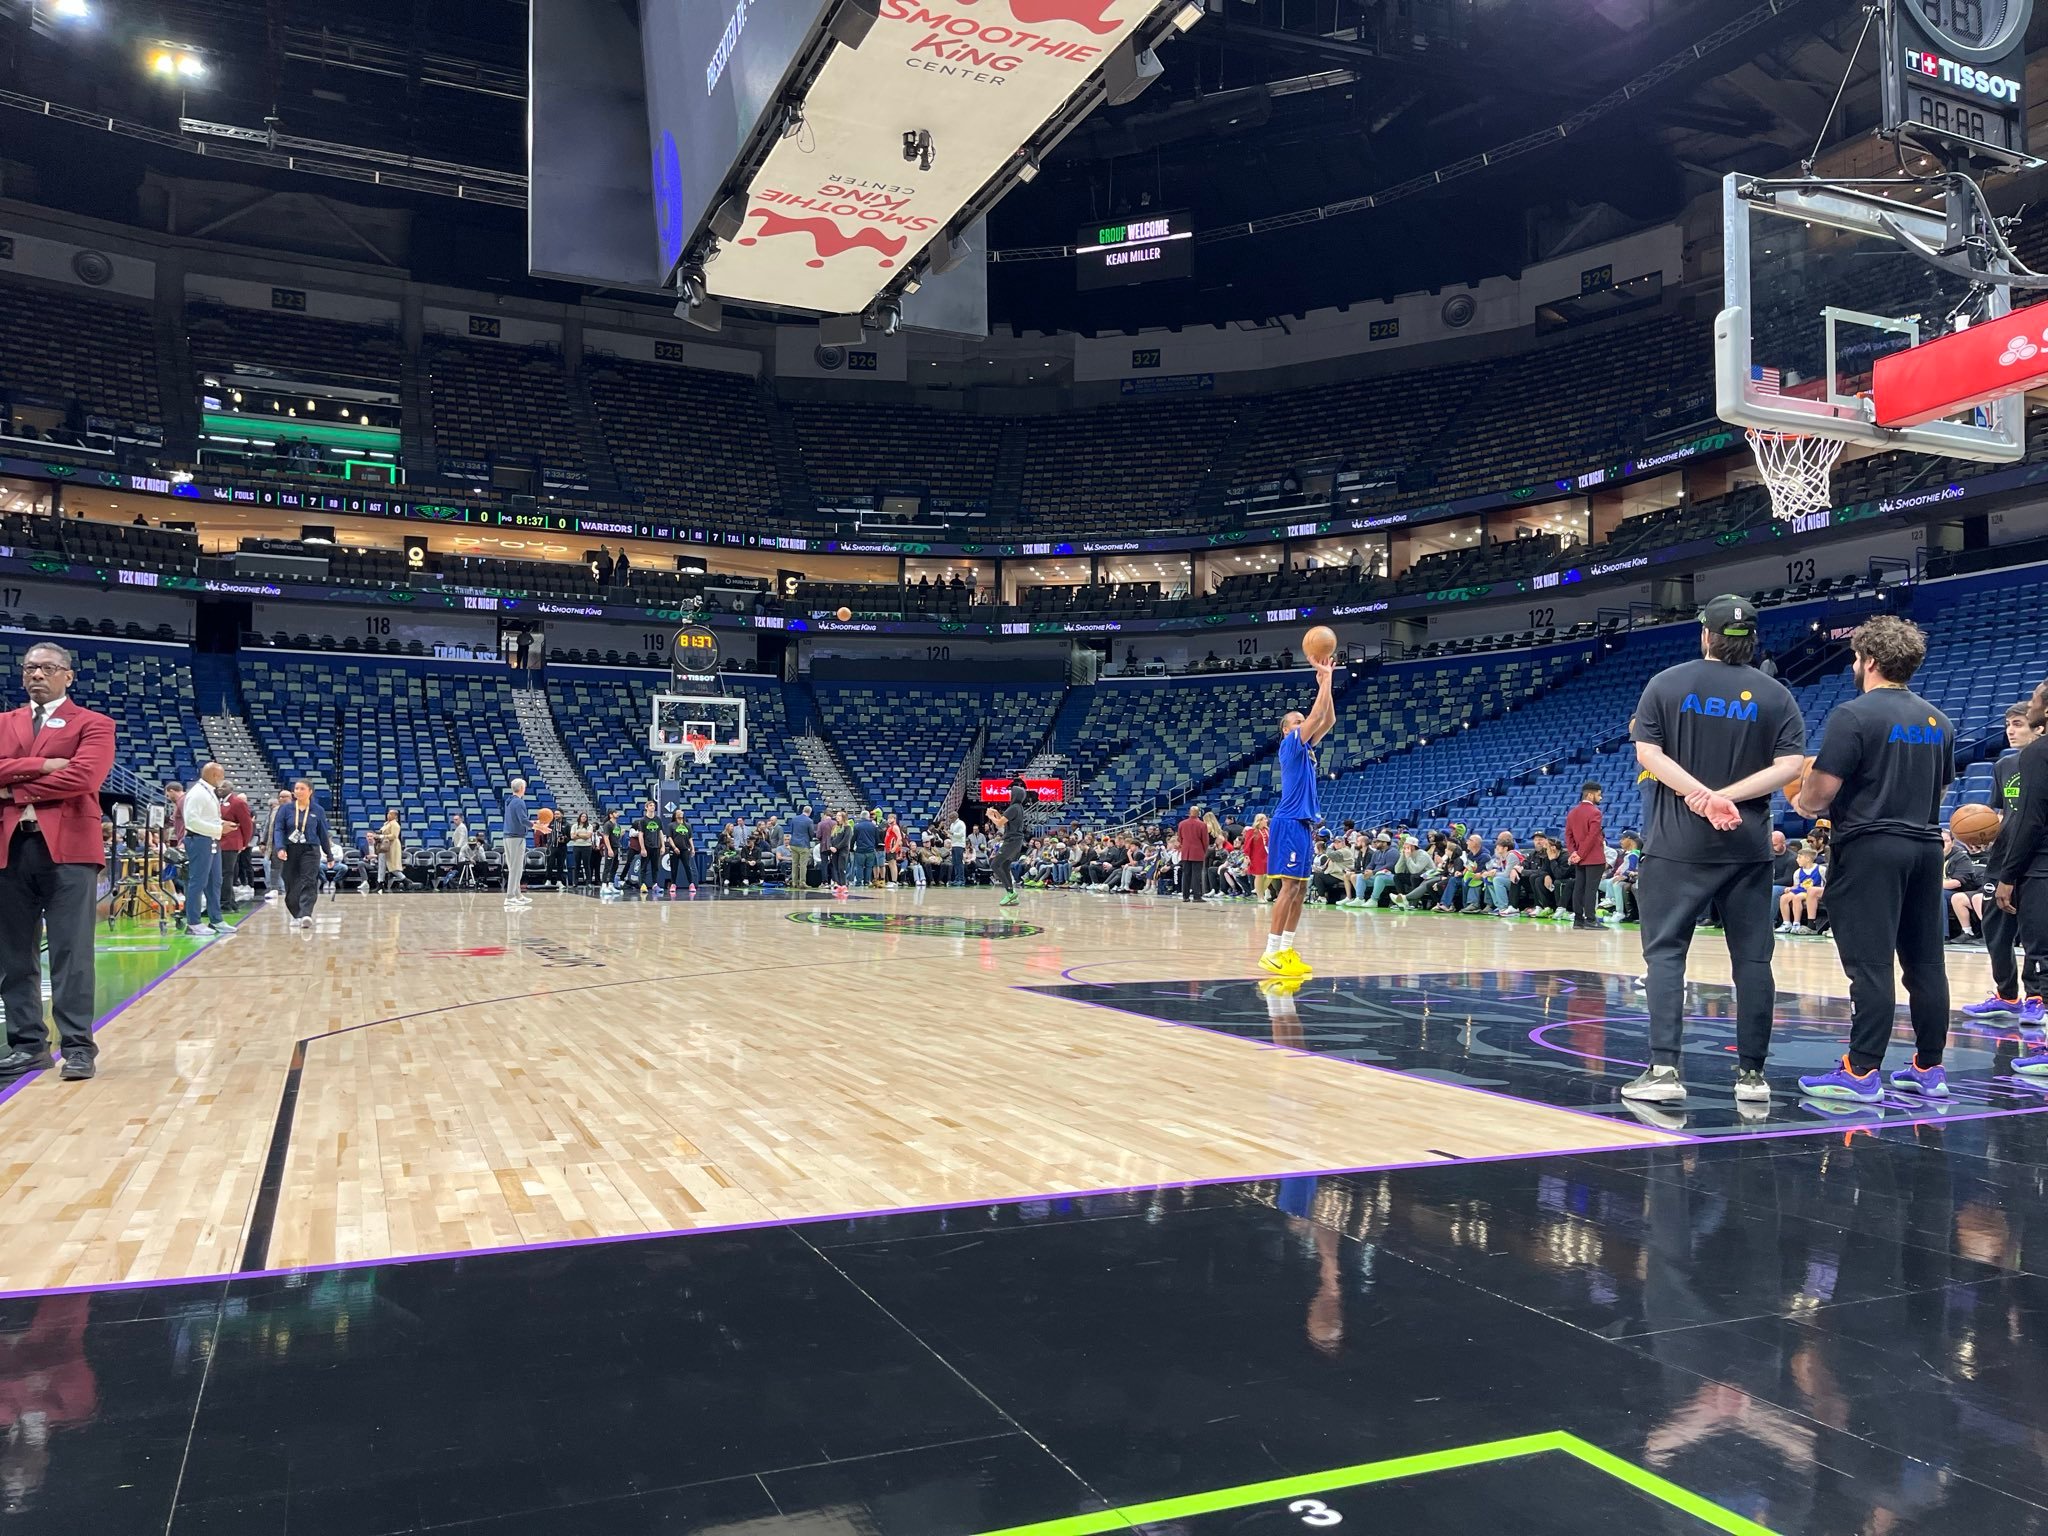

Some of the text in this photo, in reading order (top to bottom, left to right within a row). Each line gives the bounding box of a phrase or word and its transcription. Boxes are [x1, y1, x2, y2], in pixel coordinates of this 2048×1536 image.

[880, 0, 1102, 62] SMOOTHIE
[706, 15, 736, 96] PRESENTED
[906, 58, 1006, 86] CENTER
[1938, 57, 2020, 103] TISSOT
[829, 174, 915, 195] CENTER
[756, 188, 938, 231] SMOOTHIE
[1127, 219, 1170, 240] WELCOME
[1106, 247, 1160, 266] KEAN MILLER
[1583, 269, 1611, 288] 329
[470, 319, 498, 334] 324
[1370, 322, 1398, 338] 328
[656, 345, 682, 359] 325
[850, 355, 876, 367] 326
[1134, 352, 1159, 366] 327
[147, 478, 170, 493] NIGHT
[1589, 470, 1604, 486] NIGHT
[1896, 494, 1940, 510] SMOOTHIE
[234, 490, 254, 500] FOULS
[264, 494, 272, 502] 0
[310, 498, 316, 506] 7
[352, 501, 359, 510] 0
[370, 503, 382, 512] AST
[394, 506, 400, 514] 0
[480, 512, 488, 522] 0
[516, 516, 544, 526] 81:37
[558, 518, 566, 528] 0
[581, 521, 633, 534] WARRIORS
[642, 526, 647, 535] 0
[680, 531, 685, 539] 0
[761, 538, 776, 546] FOULS
[1791, 511, 1830, 533] Y2K NIGHT
[1911, 530, 1923, 540] 123
[135, 572, 158, 586] NIGHT
[1786, 559, 1815, 584] 123
[220, 583, 260, 593] SMOOTHIE
[478, 598, 498, 610] NIGHT
[366, 616, 390, 635] 118
[1529, 608, 1554, 628] 122
[643, 634, 664, 650] 119
[1237, 638, 1258, 655] 121
[926, 646, 950, 661] 120
[1680, 693, 1758, 722] ABM
[1888, 724, 1944, 745] ABM
[1288, 1499, 1343, 1527] 3
